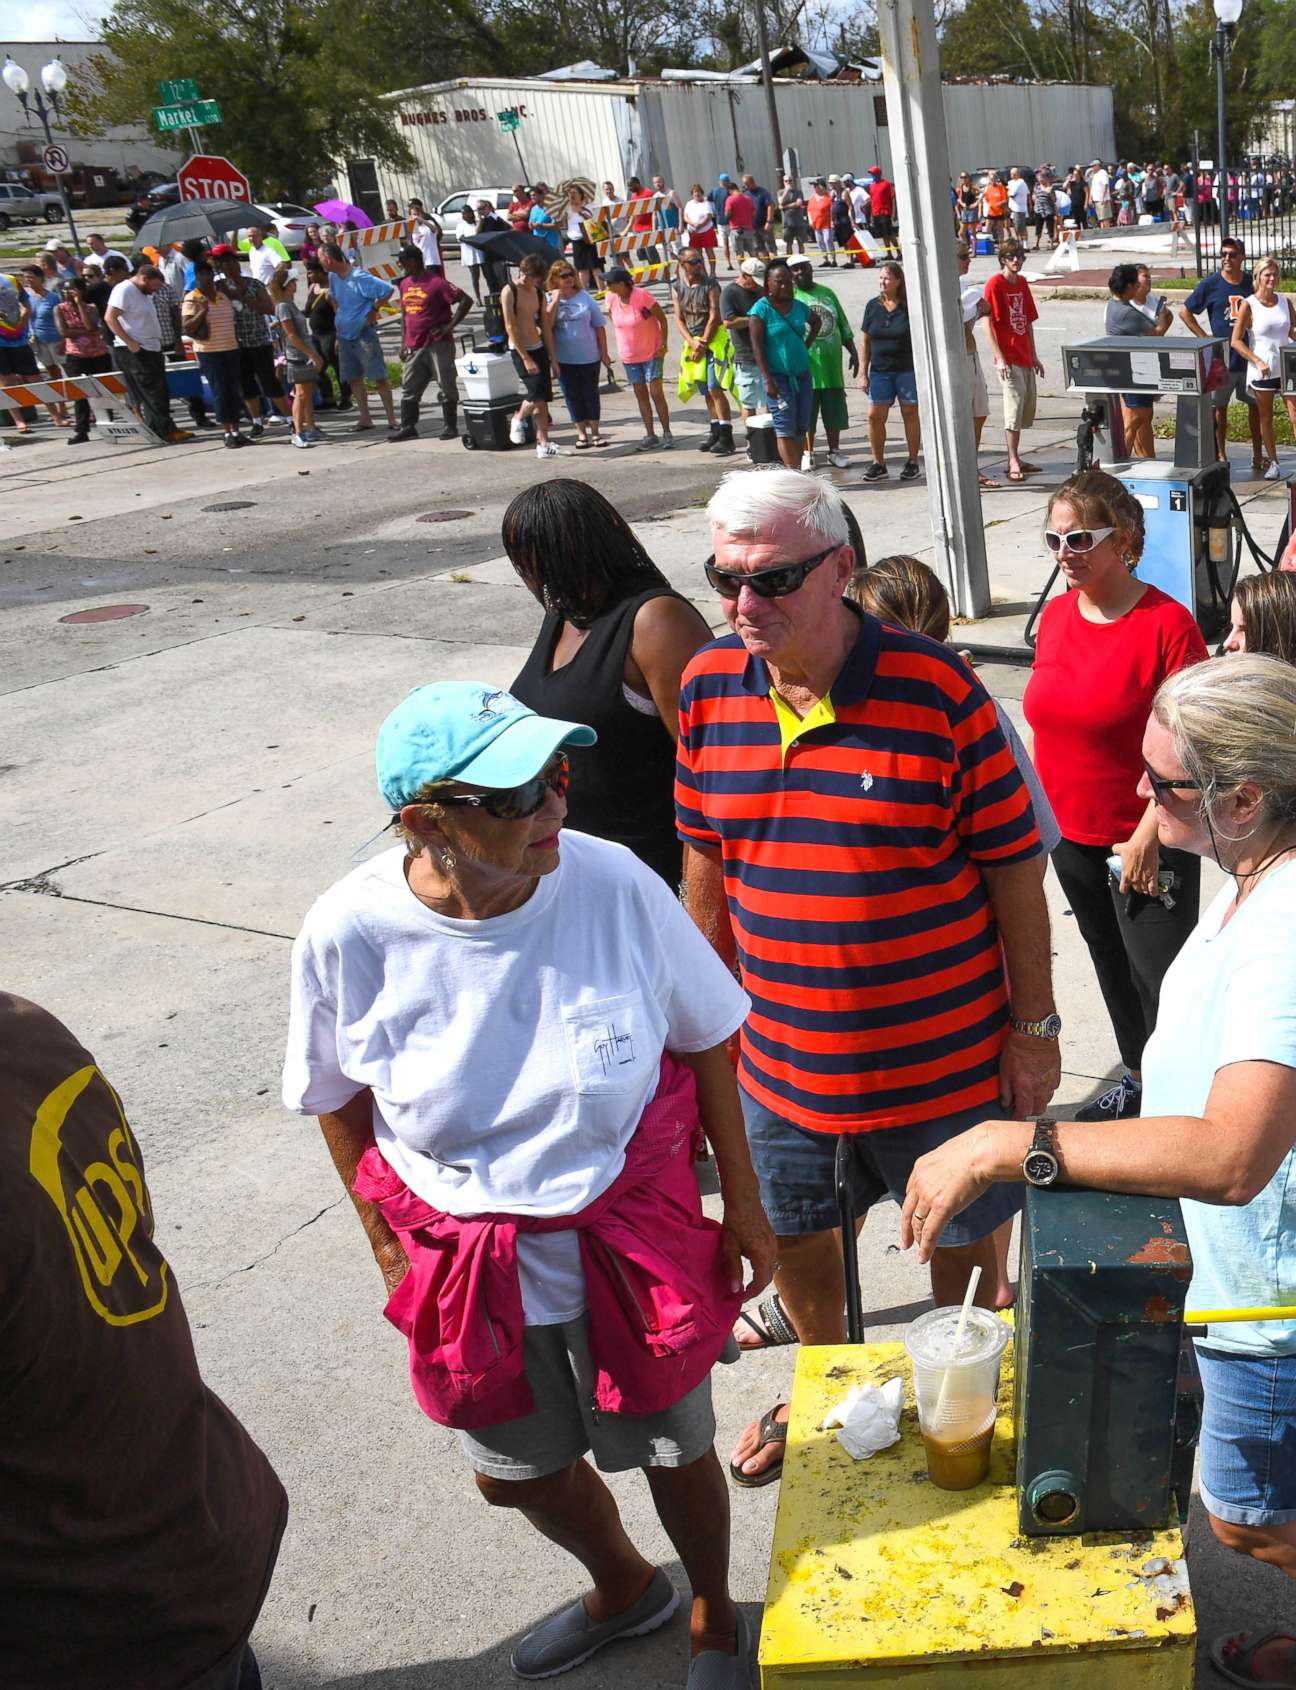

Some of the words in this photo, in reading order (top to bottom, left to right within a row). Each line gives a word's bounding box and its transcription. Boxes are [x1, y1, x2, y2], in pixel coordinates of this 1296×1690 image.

[158, 106, 198, 127] Market
[184, 177, 245, 201] STOP
[1175, 498, 1181, 510] 1
